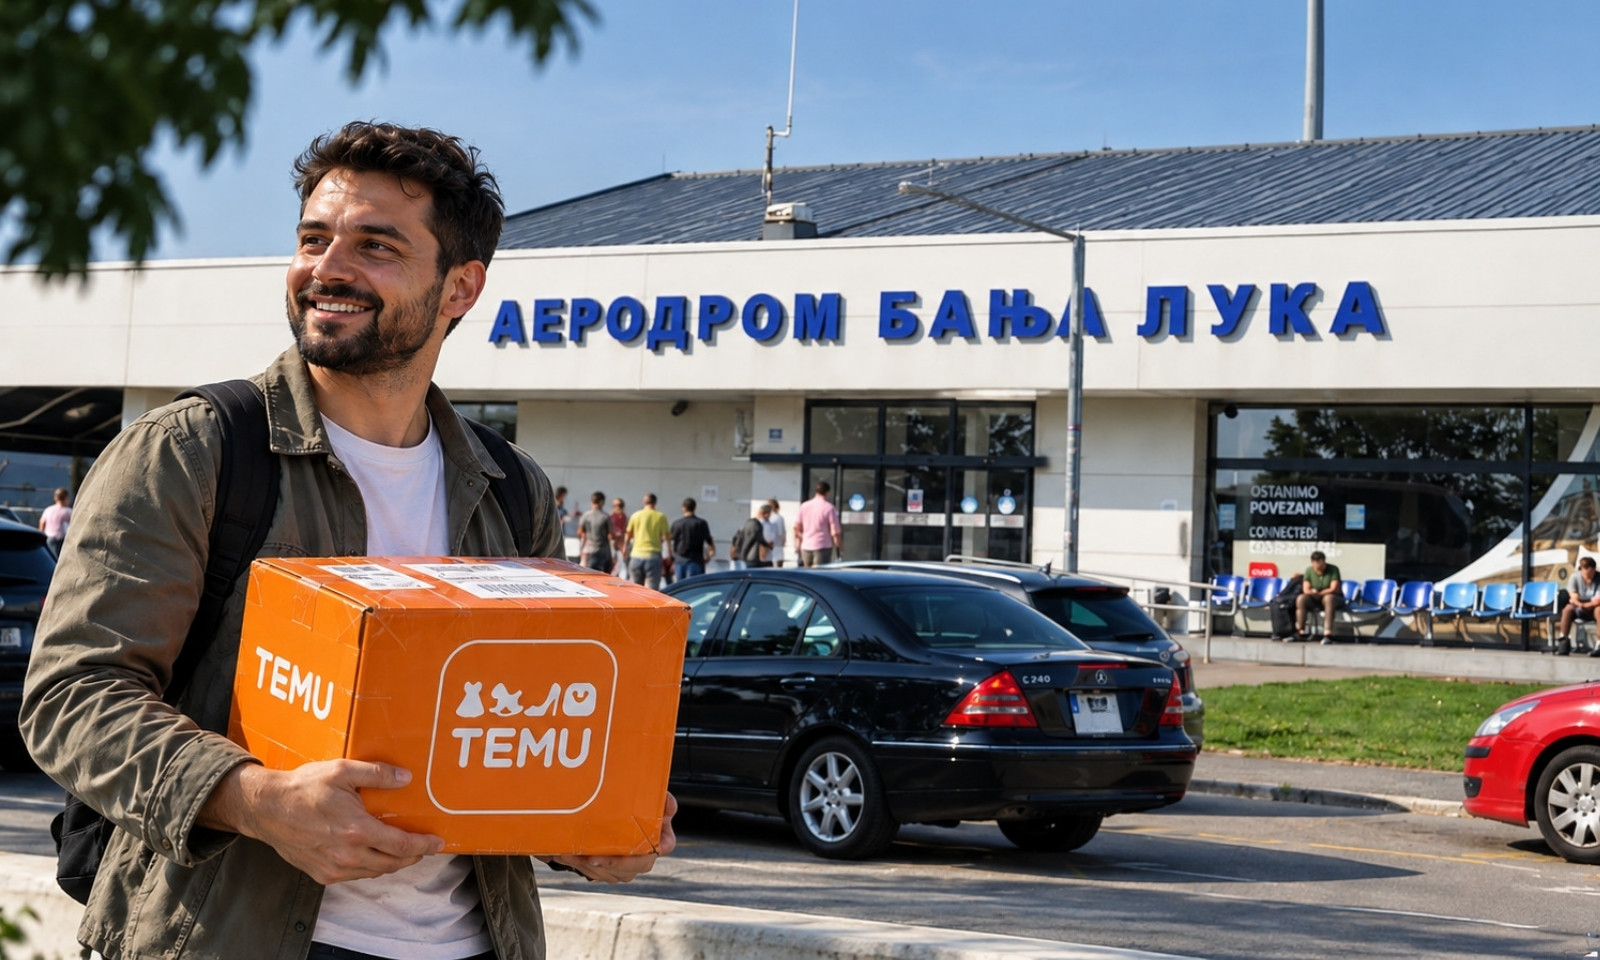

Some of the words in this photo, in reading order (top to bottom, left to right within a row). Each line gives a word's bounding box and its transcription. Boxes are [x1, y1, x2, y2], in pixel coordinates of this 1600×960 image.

[488, 293, 843, 351] АЕРОДРОМ
[878, 287, 1108, 339] БАЊА
[1136, 281, 1387, 337] ЛУКА
[1250, 485, 1319, 499] OSTANIMO
[1250, 501, 1324, 515] POVEZANI!
[1249, 526, 1318, 539] CONNECTED!
[255, 646, 334, 720] TEMU
[1031, 675, 1051, 684] 240
[452, 728, 592, 768] TEMU
